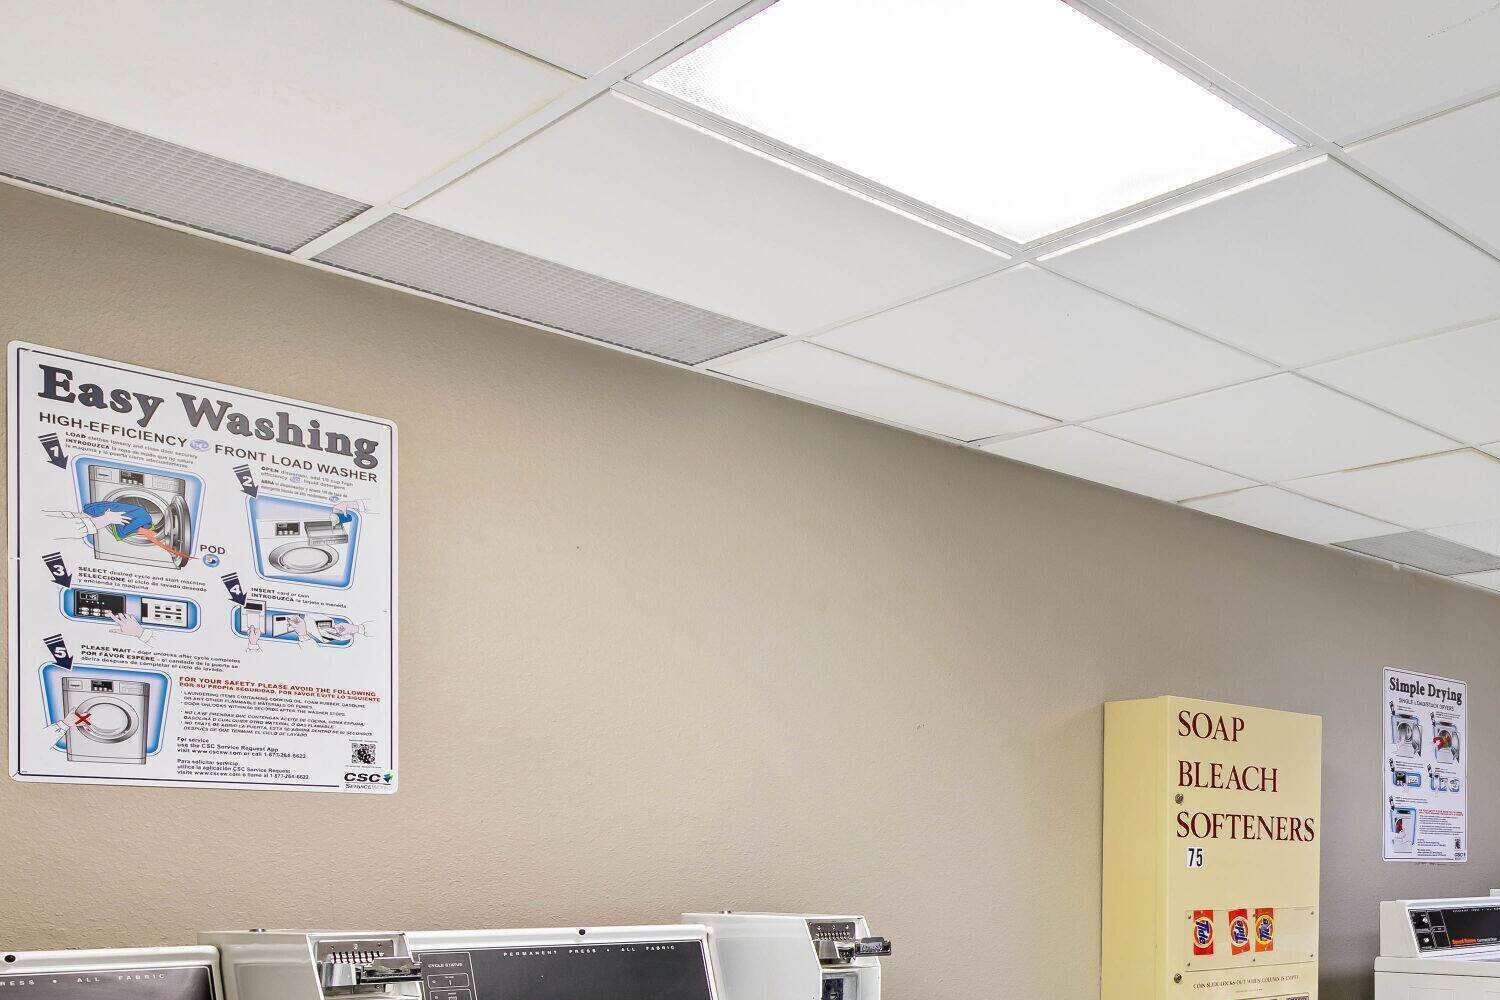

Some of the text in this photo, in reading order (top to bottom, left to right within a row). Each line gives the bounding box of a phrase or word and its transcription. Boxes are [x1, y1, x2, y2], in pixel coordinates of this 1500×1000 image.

[38, 364, 378, 469] Easy Washing
[40, 412, 188, 448] HIGH-EFFICIENCY
[65, 430, 86, 439] LOAD
[49, 446, 60, 458] 1
[215, 444, 267, 462] FRONT
[271, 454, 313, 470] LOAD
[316, 463, 378, 483] WASHER
[242, 476, 252, 486] 2
[200, 544, 226, 554] POD
[52, 564, 64, 576] 3
[78, 566, 108, 574] SELECT
[78, 572, 126, 582] SELECCIONE
[230, 584, 240, 594] 4
[251, 591, 294, 602] INTRODUZCA
[54, 647, 67, 659] 5
[126, 654, 154, 662] ESPERE
[1390, 677, 1462, 705] Simple Drying
[1178, 710, 1245, 742] SOAP
[344, 773, 381, 783] CSC
[1178, 760, 1278, 792] BLEACH
[1176, 811, 1315, 842] SOFTENERS
[1188, 848, 1203, 867] 75
